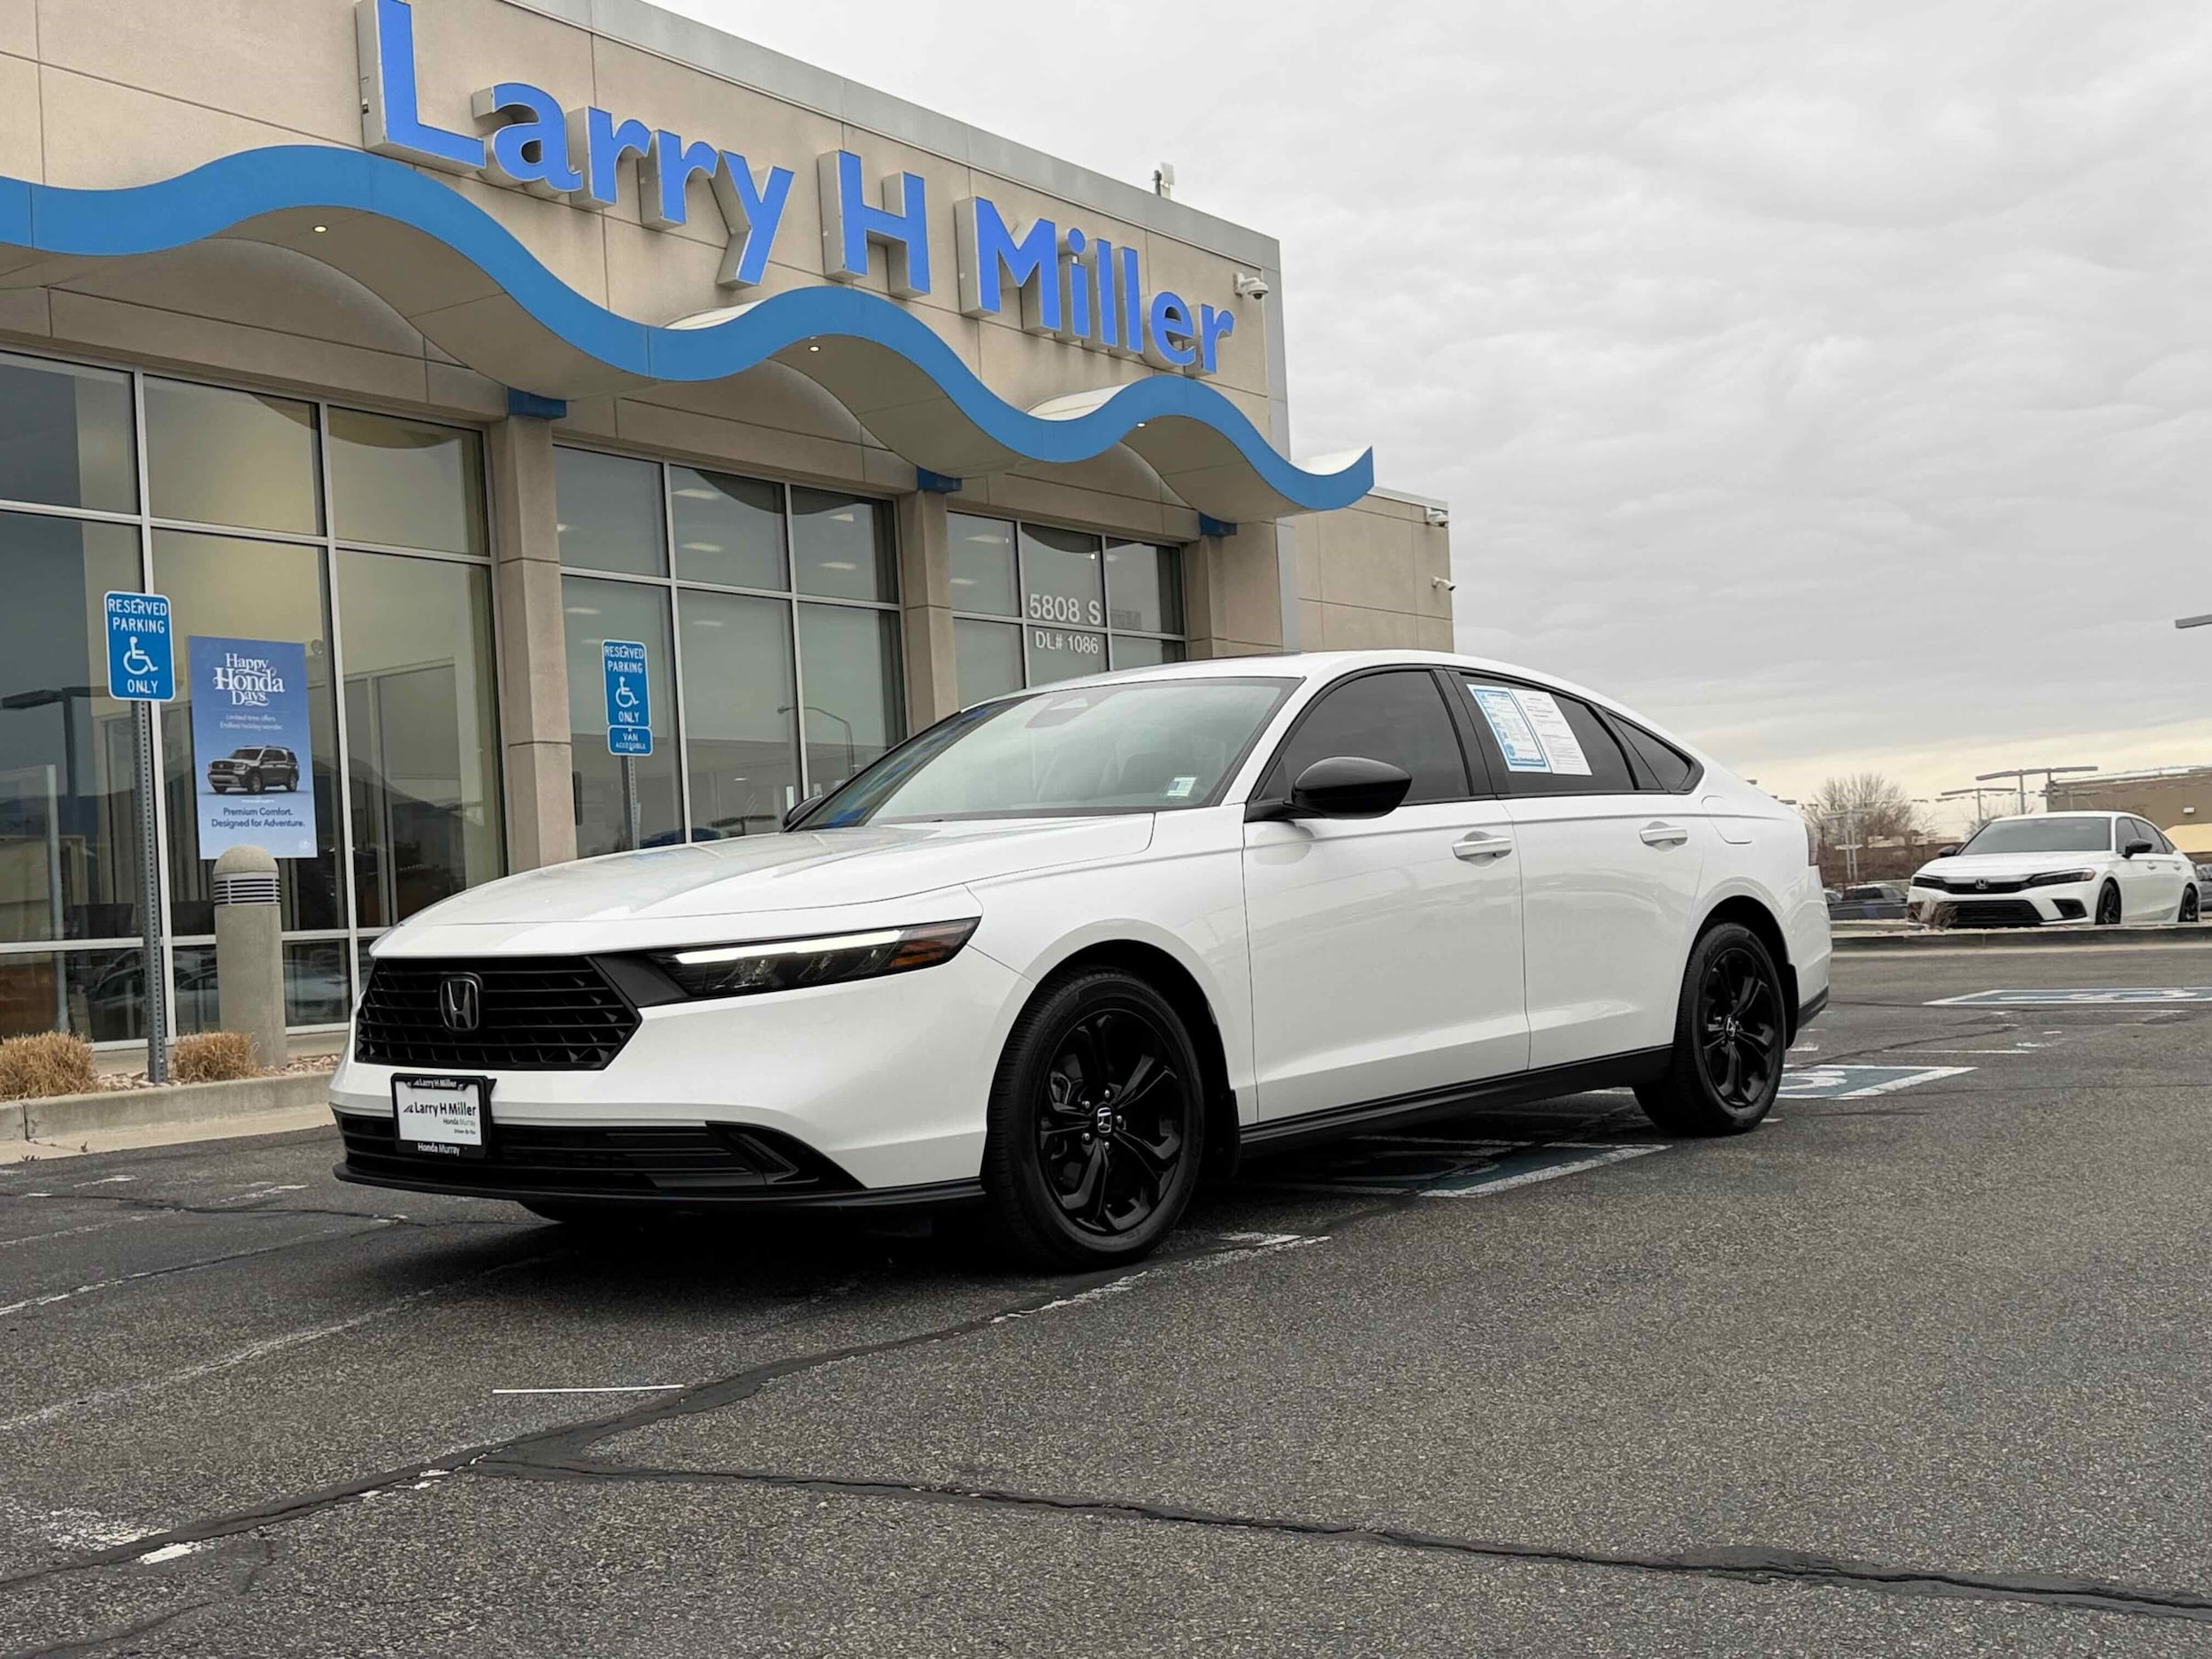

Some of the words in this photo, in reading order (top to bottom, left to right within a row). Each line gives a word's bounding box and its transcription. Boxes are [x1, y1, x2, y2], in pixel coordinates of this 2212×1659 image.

[372, 0, 795, 286] Larry
[837, 149, 931, 296] H
[974, 196, 1236, 375] Miller
[108, 598, 167, 617] RESERVED
[1029, 594, 1080, 623] 5808
[1088, 600, 1102, 626] S
[112, 617, 165, 634] PARKING
[1035, 631, 1064, 650] DL#
[1067, 634, 1099, 655] 1086
[604, 646, 644, 659] RESERVED
[225, 652, 269, 676] Happy
[608, 661, 643, 673] PARKING
[127, 679, 158, 695] ONLY
[212, 666, 285, 693] Honda
[232, 690, 270, 706] Days
[618, 710, 640, 724] ONLY
[623, 732, 639, 742] VAN
[223, 807, 258, 816] Premium
[259, 807, 293, 816] Comfort.
[211, 818, 250, 830] Designed
[250, 818, 263, 827] for
[264, 819, 304, 828] Adventure.
[419, 1078, 434, 1088] Larry
[440, 1079, 457, 1088] Miller
[415, 1101, 438, 1118] Larry
[440, 1102, 448, 1115] H
[449, 1102, 476, 1116] Miller
[418, 1142, 438, 1153] Honda
[439, 1143, 460, 1156] Murray
